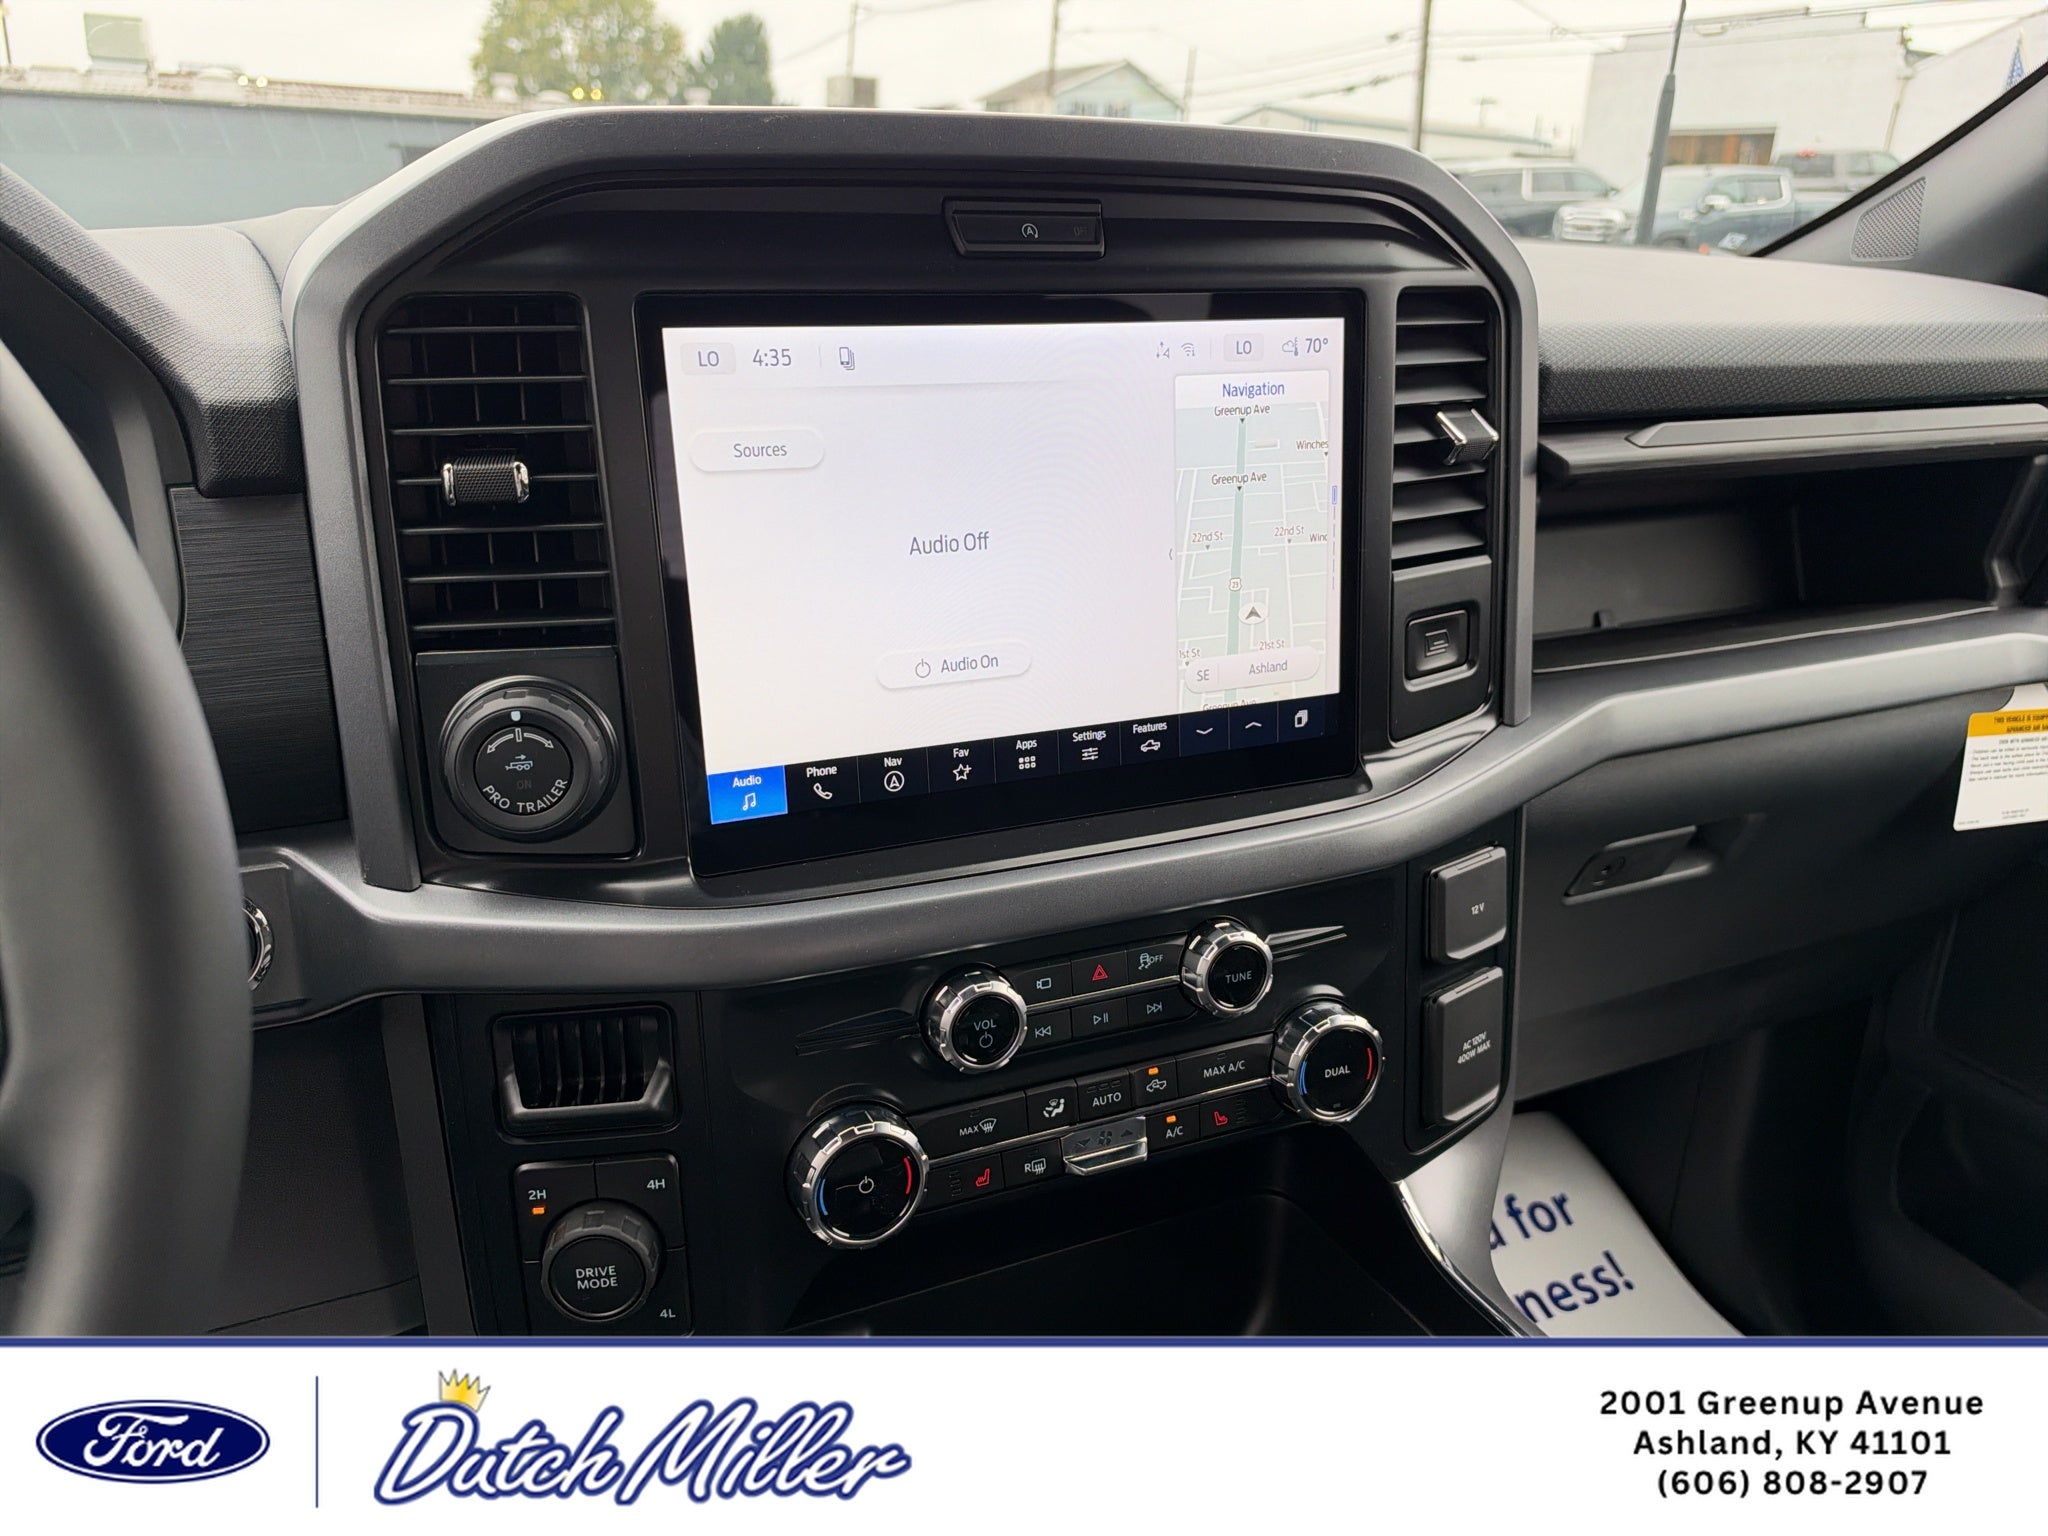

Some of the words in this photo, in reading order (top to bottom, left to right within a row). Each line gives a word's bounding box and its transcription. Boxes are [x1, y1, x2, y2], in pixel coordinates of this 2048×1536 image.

[1236, 340, 1252, 355] LO
[698, 350, 720, 367] LO
[752, 348, 792, 367] 4:35
[1222, 382, 1285, 398] Navigation
[1214, 404, 1251, 416] Greenup
[1253, 404, 1270, 414] Ave
[733, 443, 787, 458] Sources
[1211, 473, 1249, 485] Greenup
[1250, 472, 1267, 482] Ave
[1192, 532, 1212, 543] 22nd
[1213, 531, 1223, 541] St
[1274, 527, 1294, 537] 22nd
[1294, 526, 1304, 535] St
[909, 534, 959, 555] Audio
[963, 531, 989, 551] Off
[1190, 648, 1200, 657] St
[941, 657, 978, 673] Audio
[980, 654, 999, 669] On
[1249, 660, 1288, 675] Ashland
[1197, 670, 1210, 682] SE
[1132, 721, 1167, 734] Features
[1072, 729, 1106, 742] Settings
[1015, 739, 1037, 751] Apps
[953, 747, 969, 758] Fav
[884, 756, 902, 767] Nav
[806, 766, 837, 778] Phone
[732, 775, 762, 788] Audio
[483, 784, 510, 809] PRO
[517, 778, 568, 813] TRAILER
[1150, 954, 1164, 964] OFF
[1225, 970, 1252, 983] TUNE
[973, 1019, 997, 1031] VOL
[1203, 1065, 1226, 1078] MAX
[1227, 1060, 1246, 1073] A/C
[1324, 1064, 1351, 1078] DUAL
[1092, 1092, 1122, 1107] AUTO
[959, 1125, 980, 1137] MAX
[1165, 1126, 1184, 1139] A/C
[647, 1179, 666, 1190] 4H
[528, 1189, 547, 1200] 2H
[1504, 1193, 1573, 1239] for
[575, 1265, 616, 1279] DRIVE
[577, 1277, 618, 1290] MODE
[660, 1308, 676, 1318] 4L
